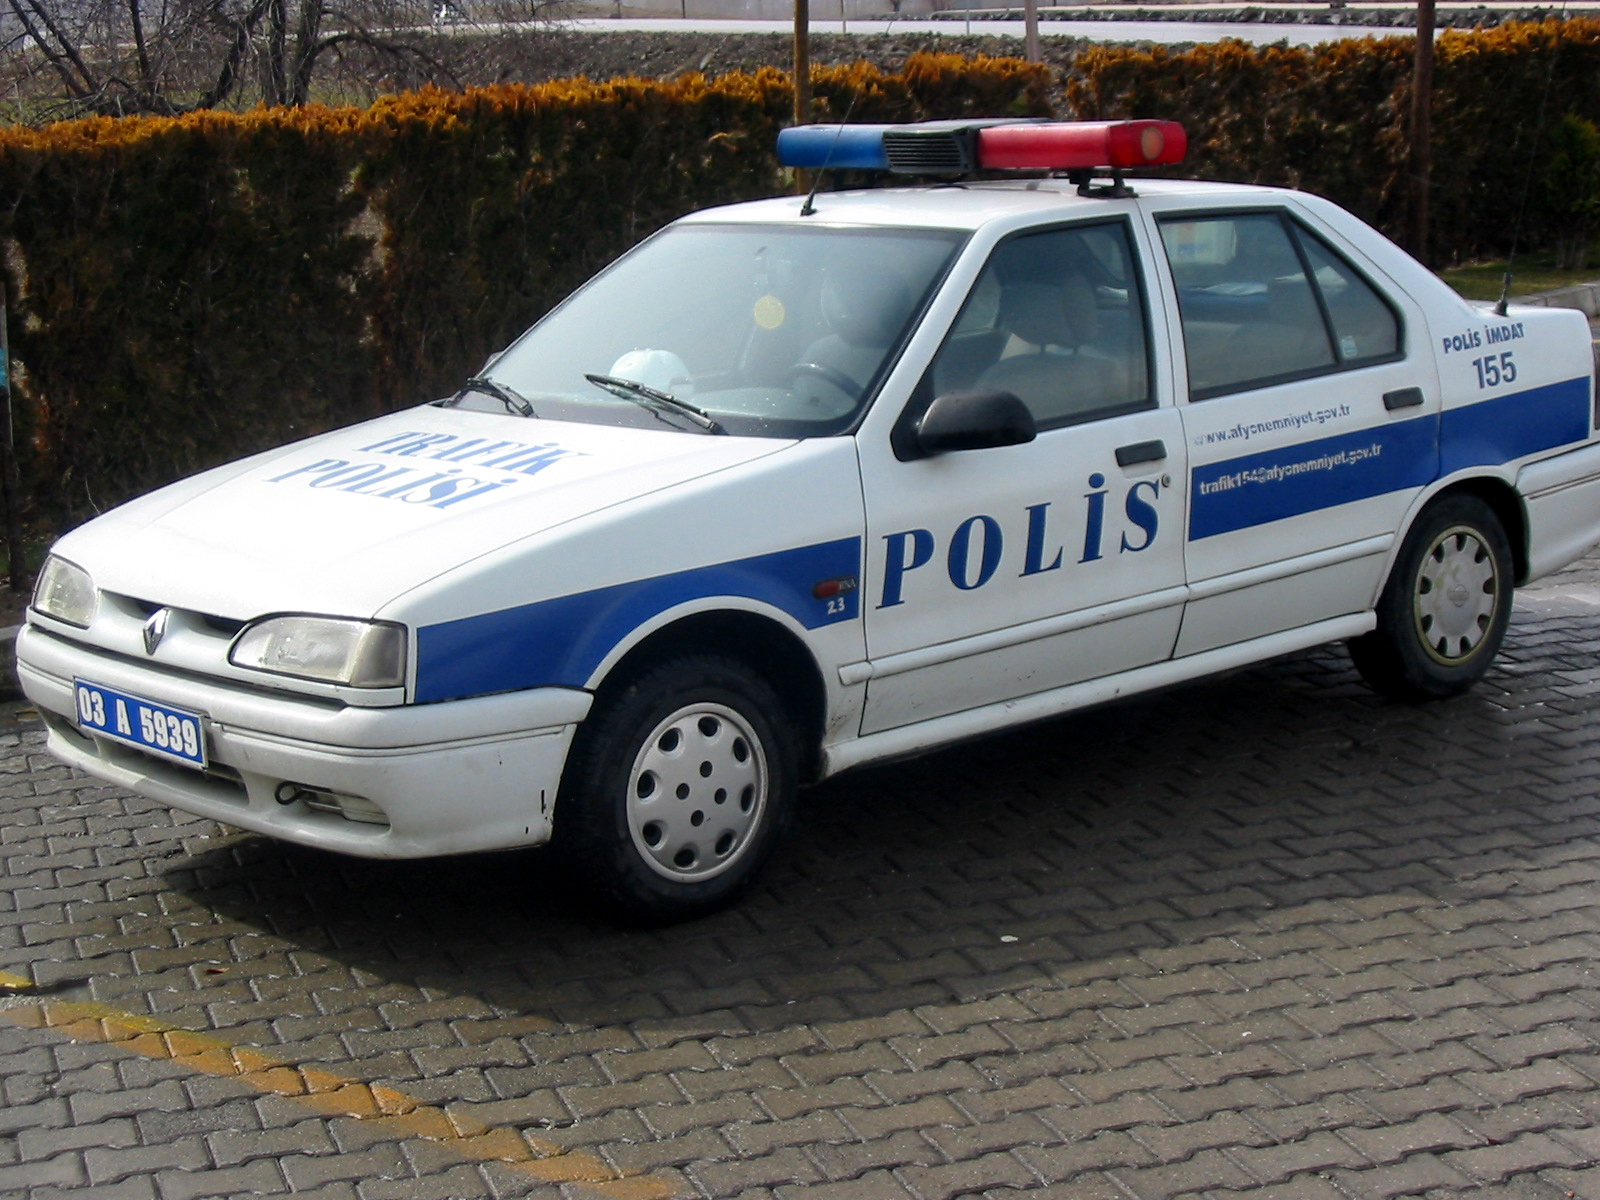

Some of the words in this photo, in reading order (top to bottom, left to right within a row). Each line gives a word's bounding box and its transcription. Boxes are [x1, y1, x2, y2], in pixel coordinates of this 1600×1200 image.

[1442, 328, 1481, 354] POLİS
[1484, 322, 1524, 344] İMDAT
[1472, 351, 1517, 389] 155
[355, 431, 592, 475] TRAFİK
[263, 458, 518, 509] POLİSİ
[875, 472, 1160, 609] POLİS
[827, 597, 846, 615] 23
[78, 686, 107, 727] 03
[115, 698, 132, 736] A
[139, 706, 198, 757] 5939
